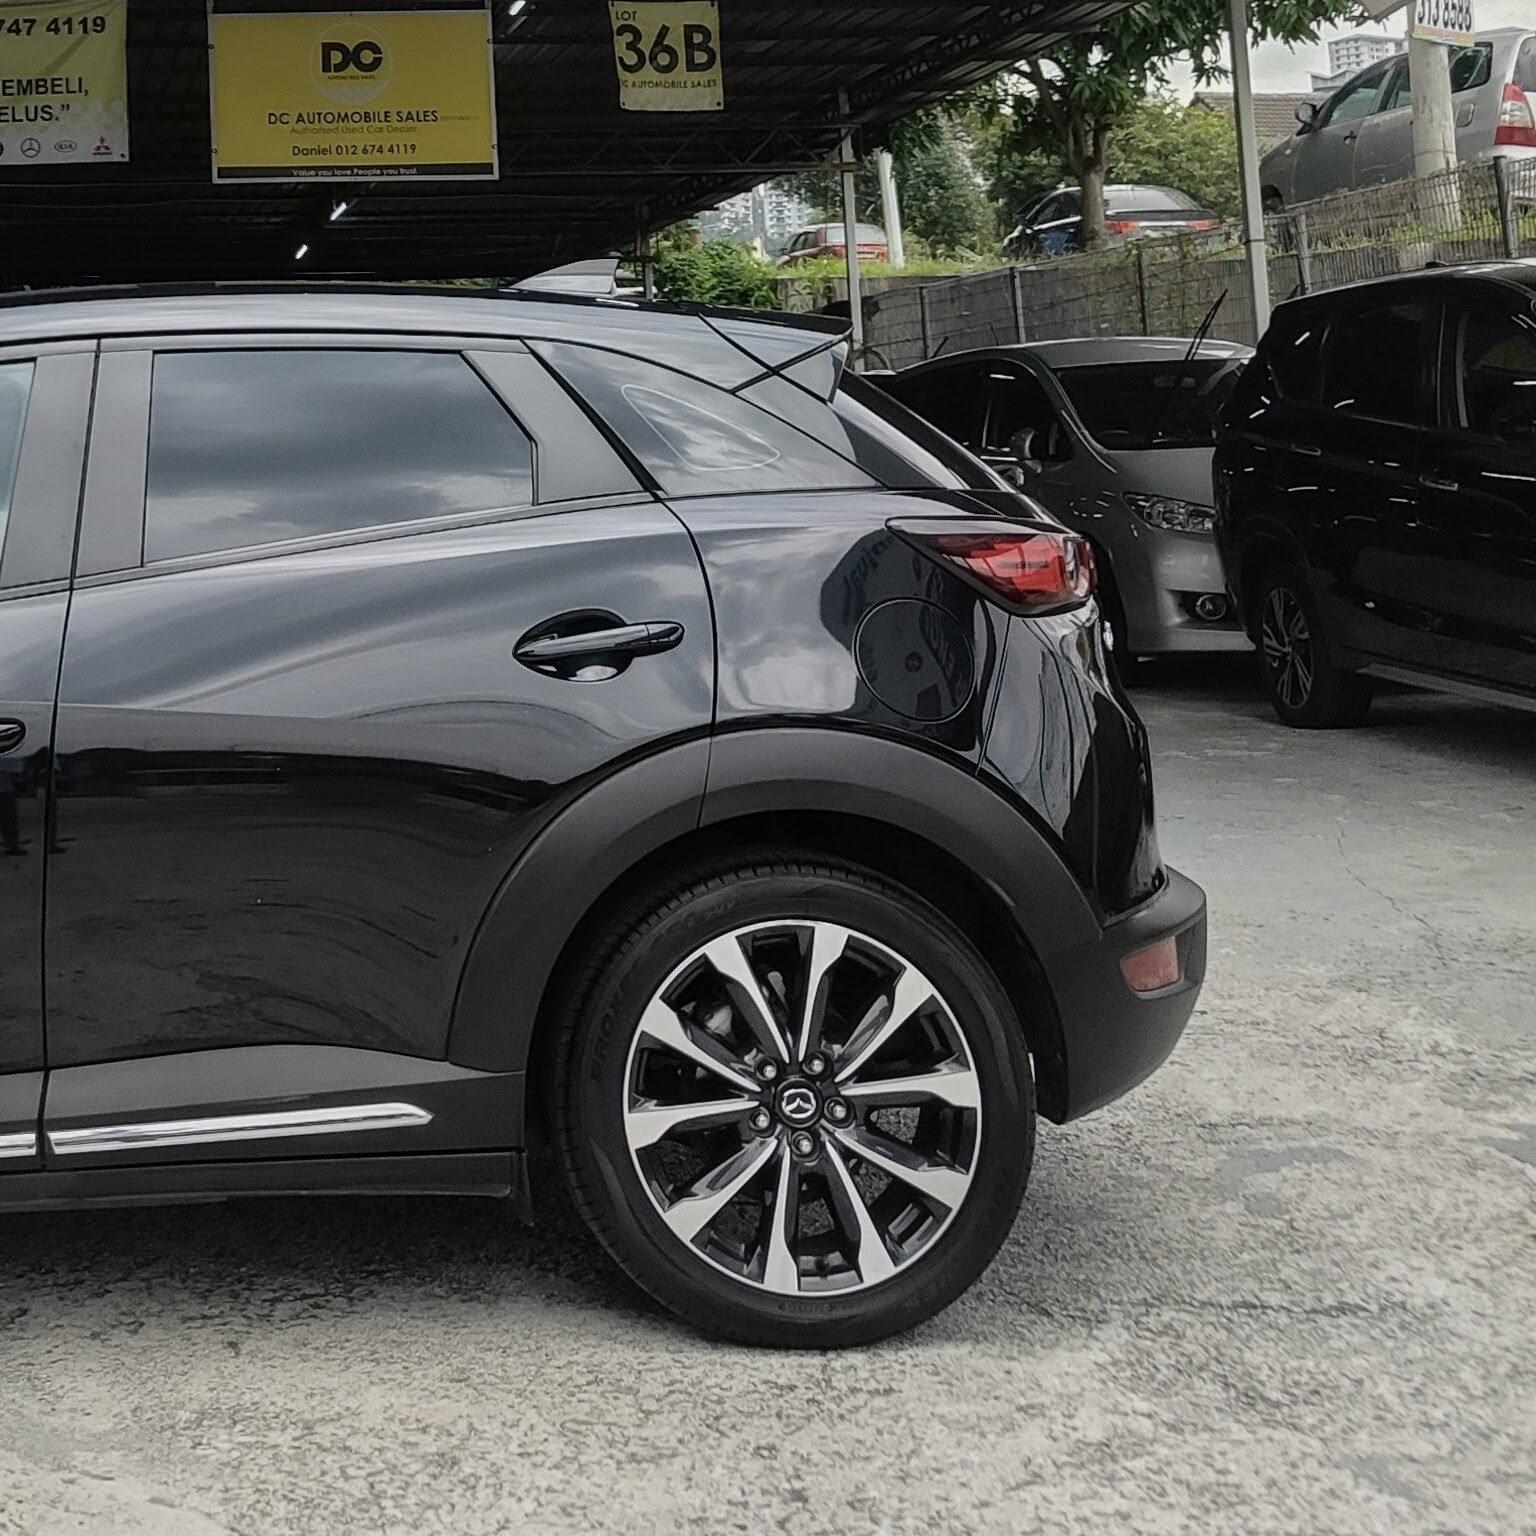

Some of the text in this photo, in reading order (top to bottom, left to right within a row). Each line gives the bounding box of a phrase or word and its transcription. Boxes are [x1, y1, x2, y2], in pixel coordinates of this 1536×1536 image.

[616, 10, 637, 21] LOT
[45, 15, 106, 34] 4119
[616, 24, 717, 74] 36B
[321, 40, 383, 73] DC
[631, 79, 688, 89] AUTOMOBILE
[691, 79, 717, 89] SALES
[268, 112, 290, 125] DC
[295, 110, 391, 125] AUTOMOBILE
[396, 110, 438, 123] SALES
[341, 126, 364, 134] Used
[366, 125, 384, 133] Car
[386, 124, 417, 133] Dealer
[292, 143, 417, 156] Daniel 012 674 4119
